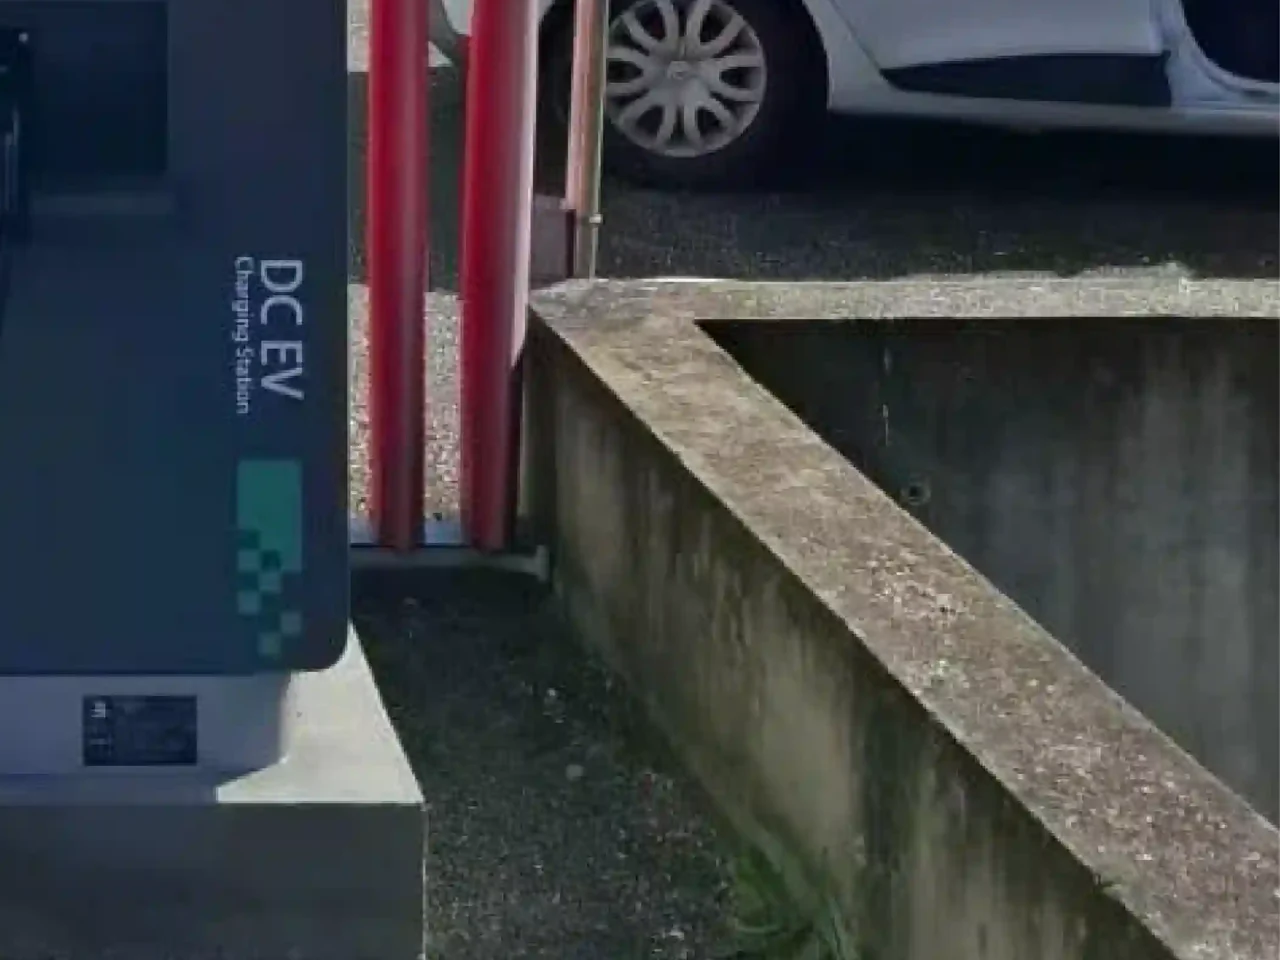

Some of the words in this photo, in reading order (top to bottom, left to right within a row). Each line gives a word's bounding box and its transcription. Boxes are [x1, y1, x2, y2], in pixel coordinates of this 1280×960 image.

[231, 256, 254, 342] Charging
[260, 259, 303, 326] DC
[235, 344, 255, 414] Station
[260, 340, 305, 401] EV
